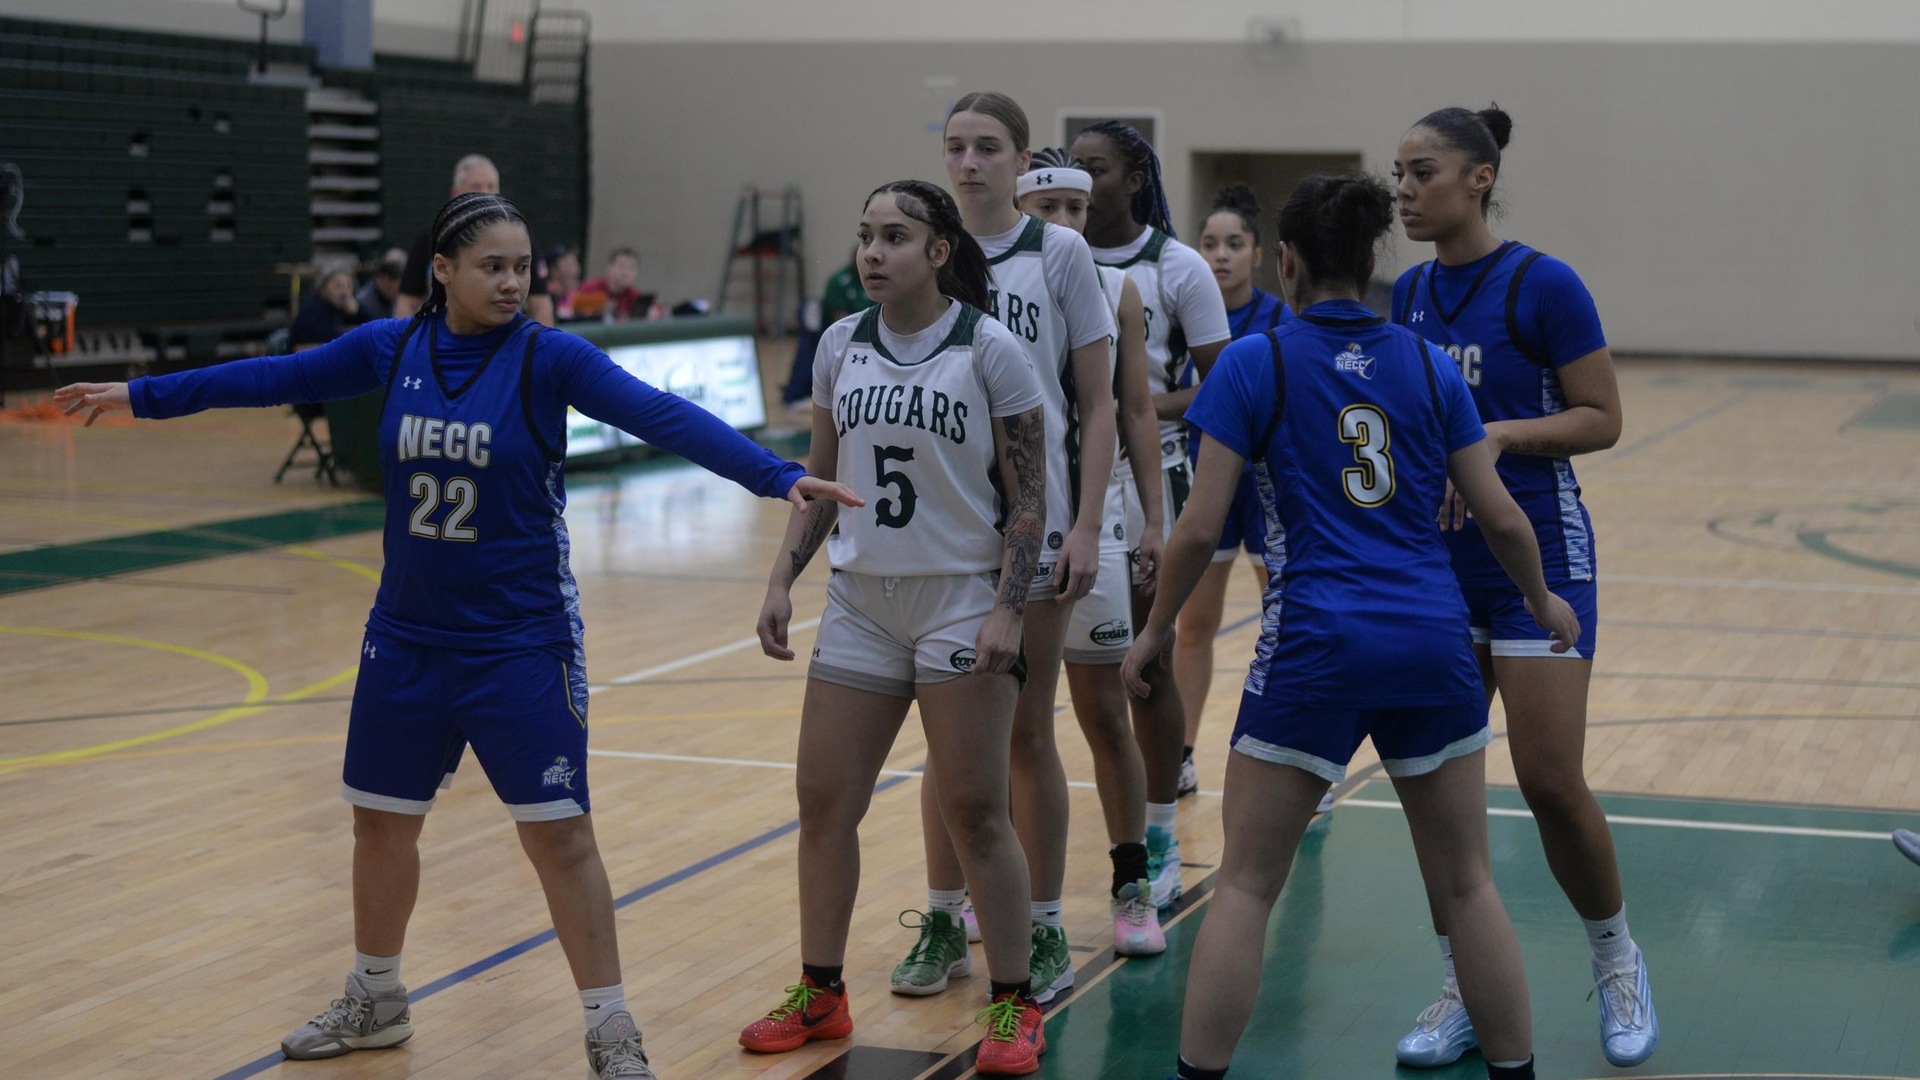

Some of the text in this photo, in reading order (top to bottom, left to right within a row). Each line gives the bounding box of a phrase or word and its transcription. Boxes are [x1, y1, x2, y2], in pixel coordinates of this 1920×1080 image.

[1335, 359, 1367, 371] NECC
[398, 413, 492, 469] NECC
[837, 384, 968, 444] COUGARS
[1337, 403, 1397, 508] 3
[408, 471, 478, 542] 22
[872, 444, 918, 529] 5
[543, 772, 572, 785] NECC
